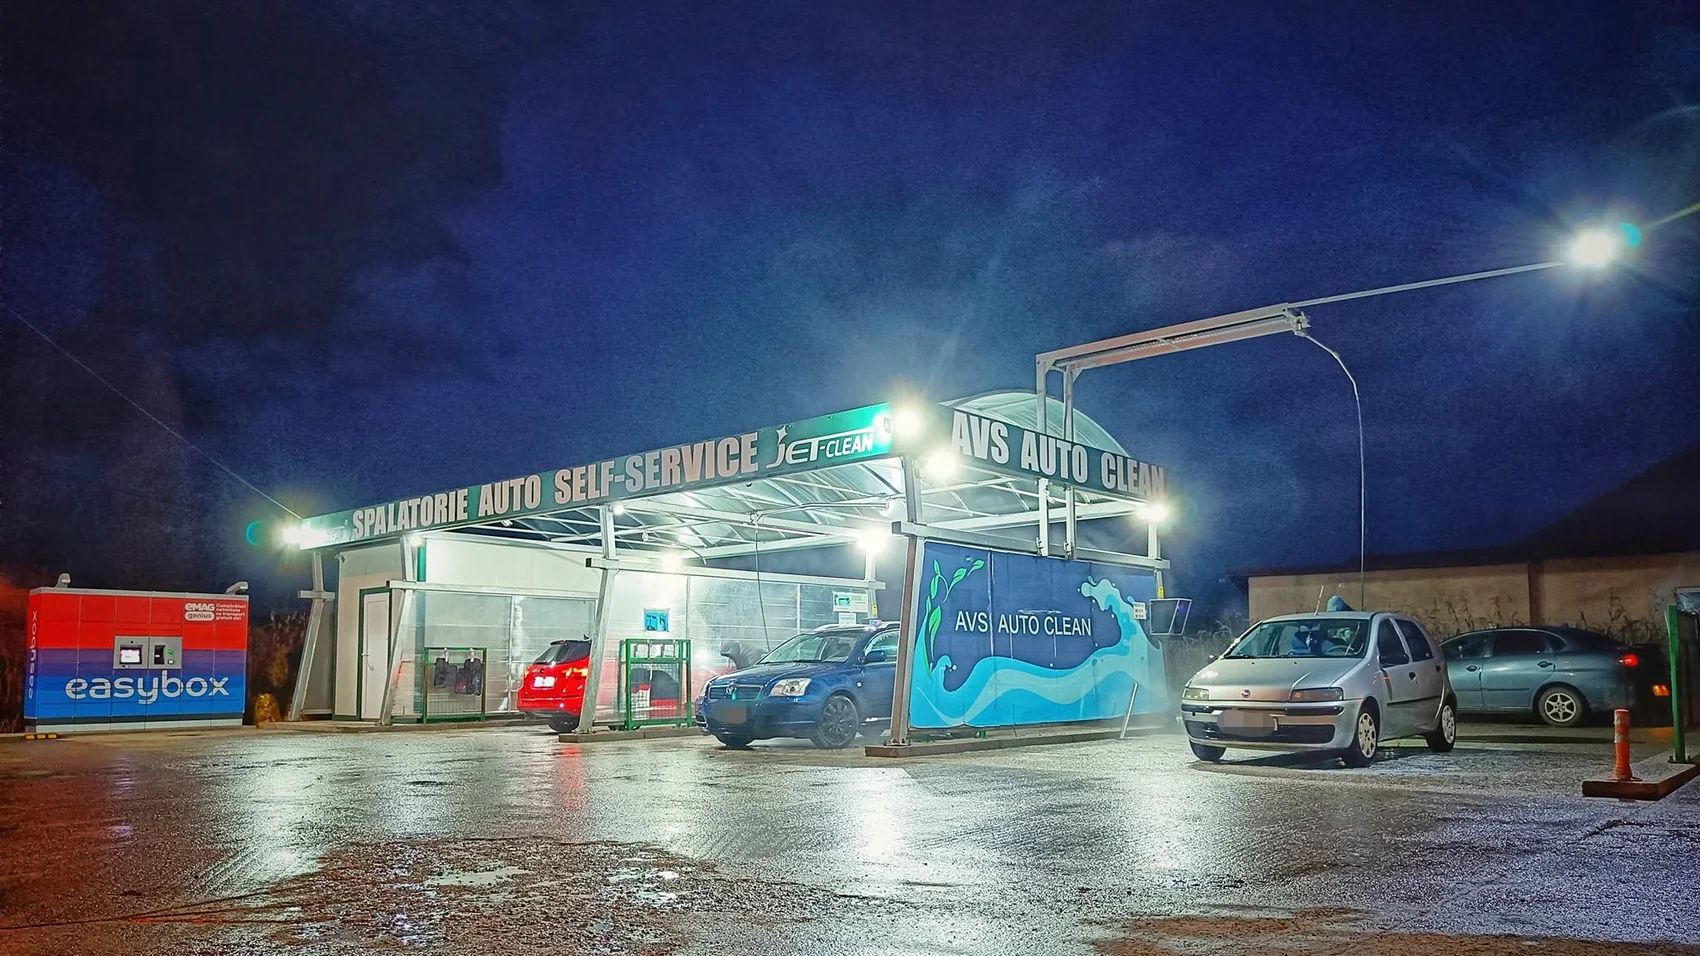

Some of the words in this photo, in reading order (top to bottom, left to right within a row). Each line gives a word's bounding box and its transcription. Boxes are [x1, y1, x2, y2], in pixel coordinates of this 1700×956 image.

[352, 488, 468, 539] SPALATORIE
[478, 474, 542, 518] AUTO
[554, 432, 759, 505] SELF-SERVICE
[953, 410, 1011, 465] AVS
[1020, 433, 1089, 484] AUTO
[1100, 452, 1165, 498] CLEAN
[28, 610, 37, 699] easybox
[955, 610, 988, 633] AVS
[998, 612, 1039, 635] AUTO
[1043, 613, 1092, 637] CLEAN
[65, 670, 229, 704] easybox
